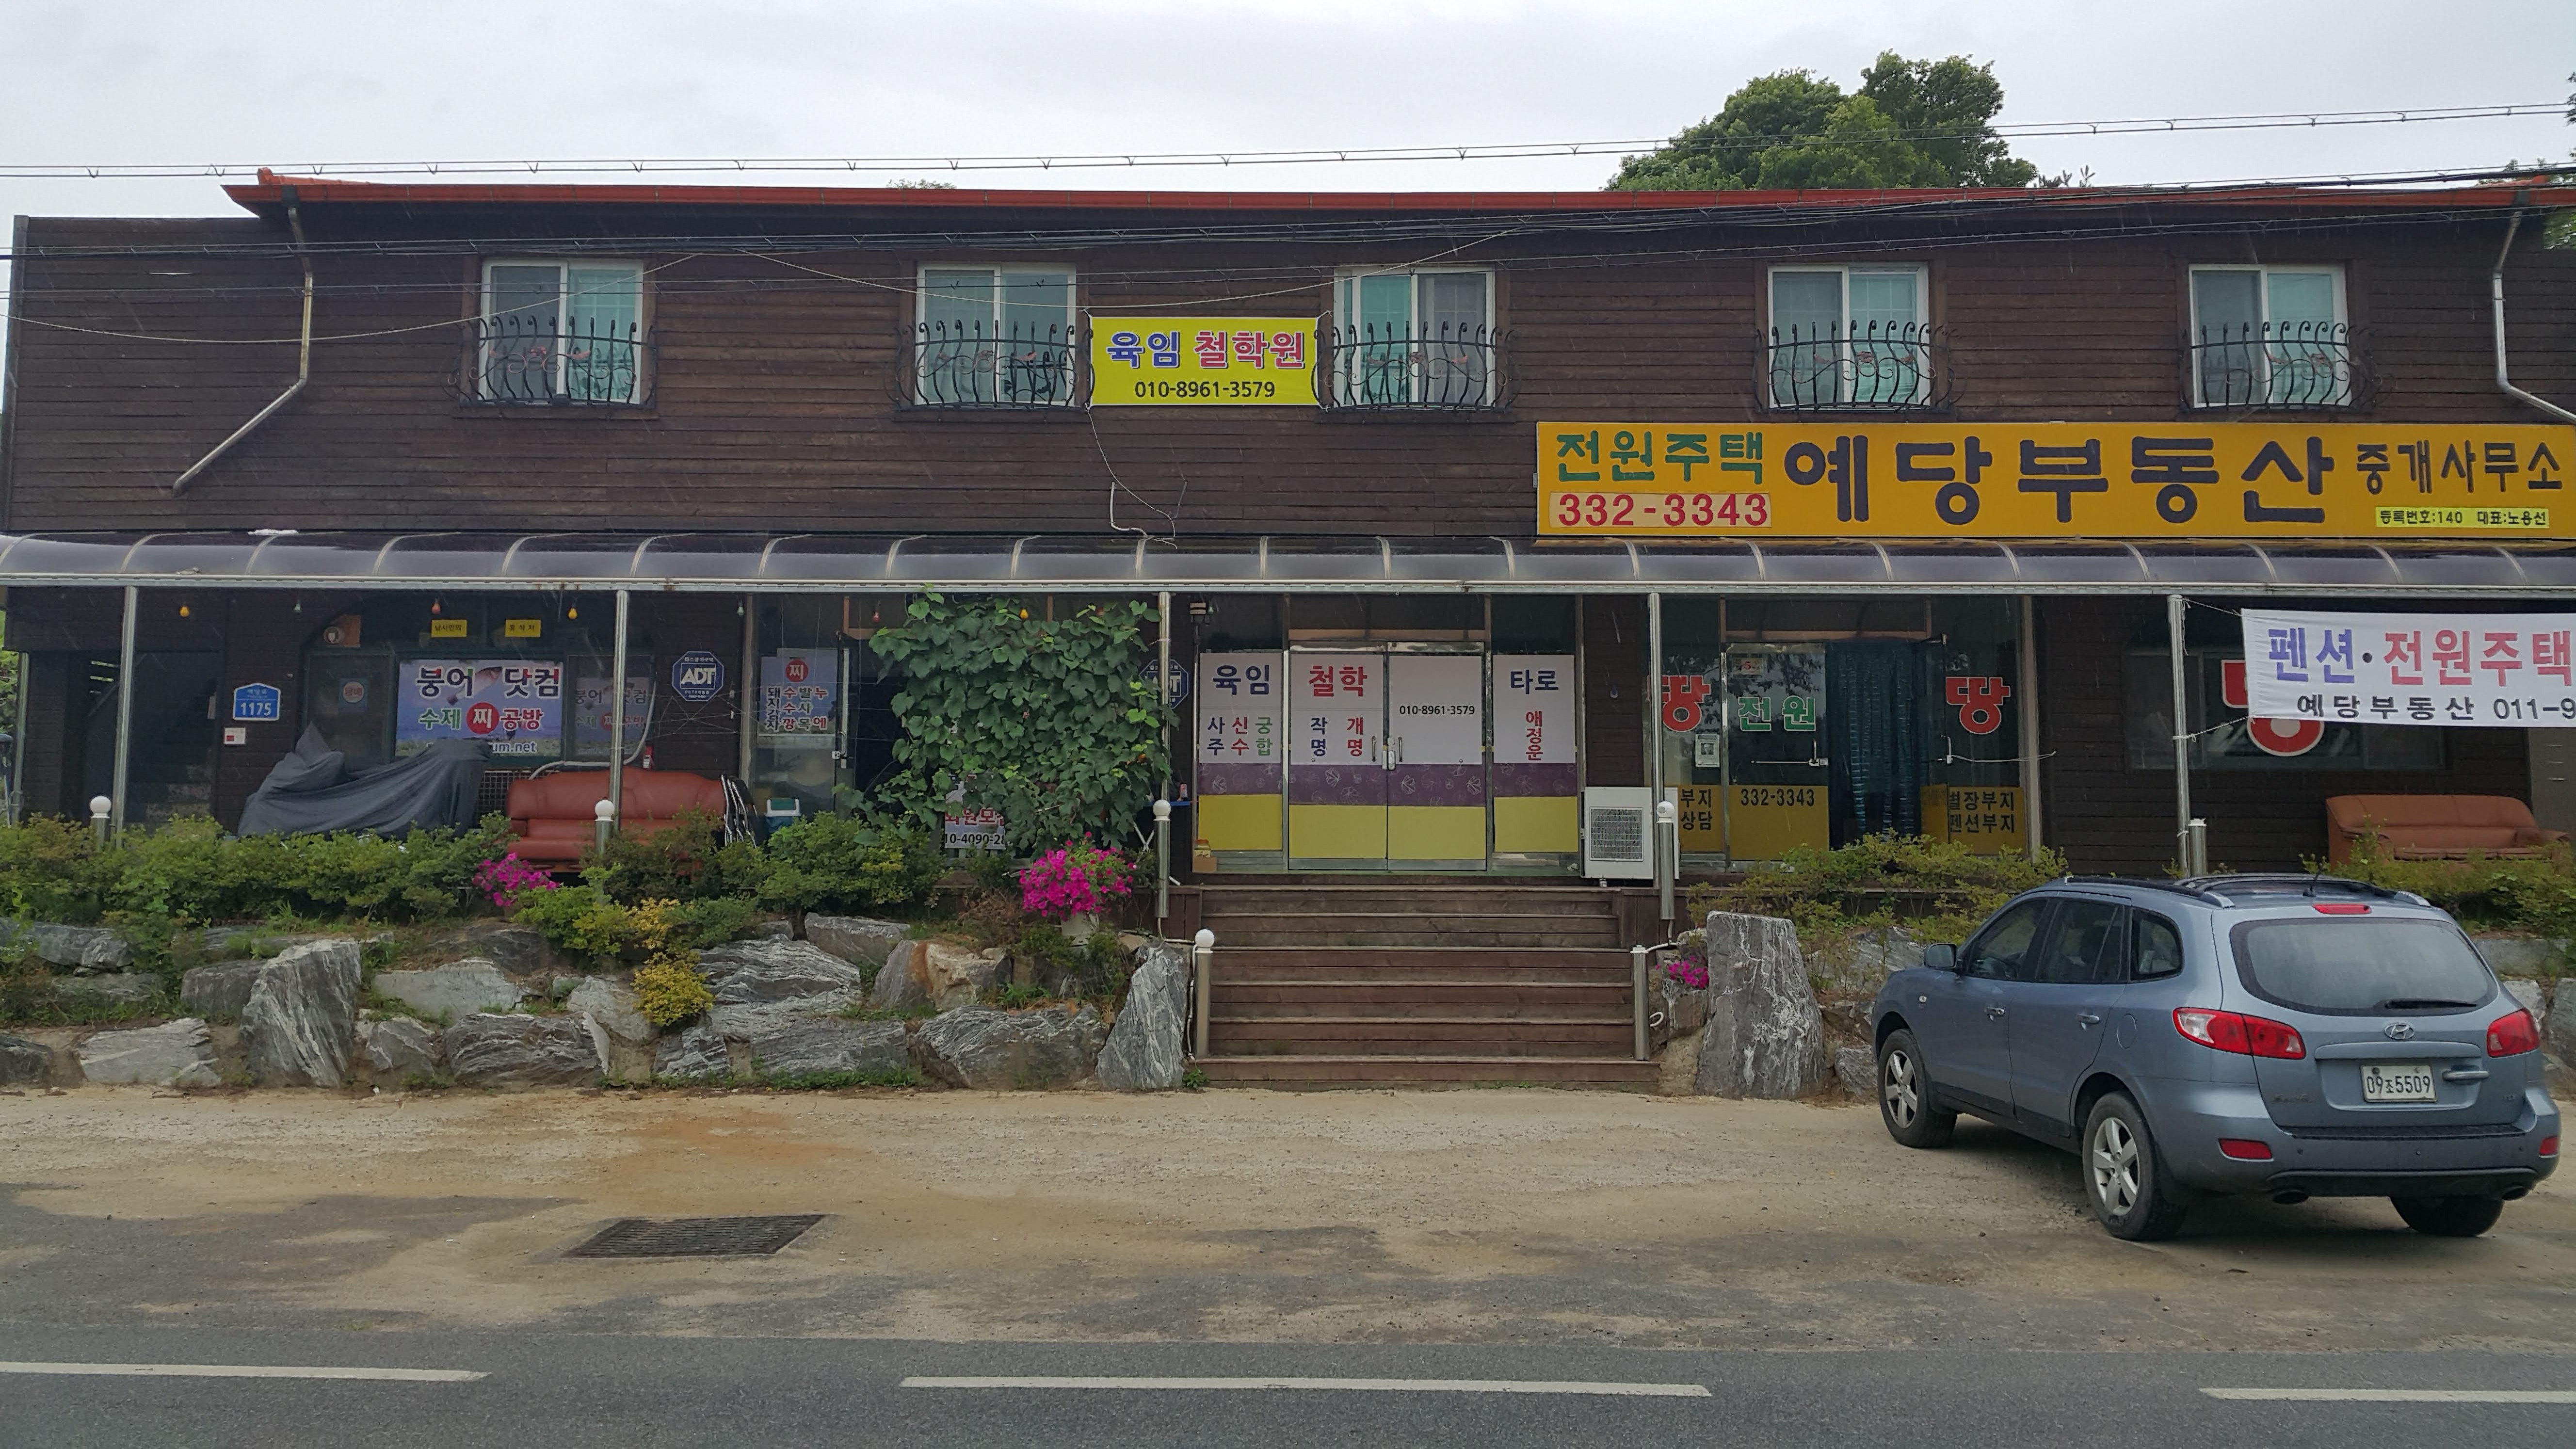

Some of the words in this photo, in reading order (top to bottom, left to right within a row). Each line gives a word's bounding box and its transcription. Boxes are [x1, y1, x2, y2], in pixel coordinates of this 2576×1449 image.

[1106, 330, 1180, 369] 육임
[1193, 330, 1305, 369] 철학원
[1135, 381, 1275, 398] 010-8961-3579
[1556, 430, 1764, 484] 전원주택
[1784, 435, 2334, 525] 예당부동산
[2356, 440, 2563, 494] 중개사무소
[1558, 493, 1768, 527] 332-3343
[417, 667, 474, 697] 붕어
[504, 668, 560, 697] 닷컴
[681, 667, 716, 685] ADT
[789, 664, 804, 680] 찌
[1212, 665, 1270, 695] 육임
[1309, 666, 1368, 697] 철학
[1510, 669, 1559, 694] 타로
[240, 702, 272, 716] 1175
[419, 708, 461, 729] 수제
[472, 708, 493, 729] 찌
[500, 708, 543, 730] 공방
[1399, 706, 1475, 715] 010-8961-3579
[1738, 695, 1817, 732] 전원
[1946, 676, 2011, 735] 땅
[2297, 693, 2474, 720] 예당부동산
[1310, 717, 1328, 757] 작명
[1347, 717, 1364, 757] 개명
[1525, 710, 1544, 761] 애정운
[1740, 788, 1815, 807] 332-3343
[1681, 810, 1713, 831] 상담
[2367, 1075, 2431, 1094] 09조5509
